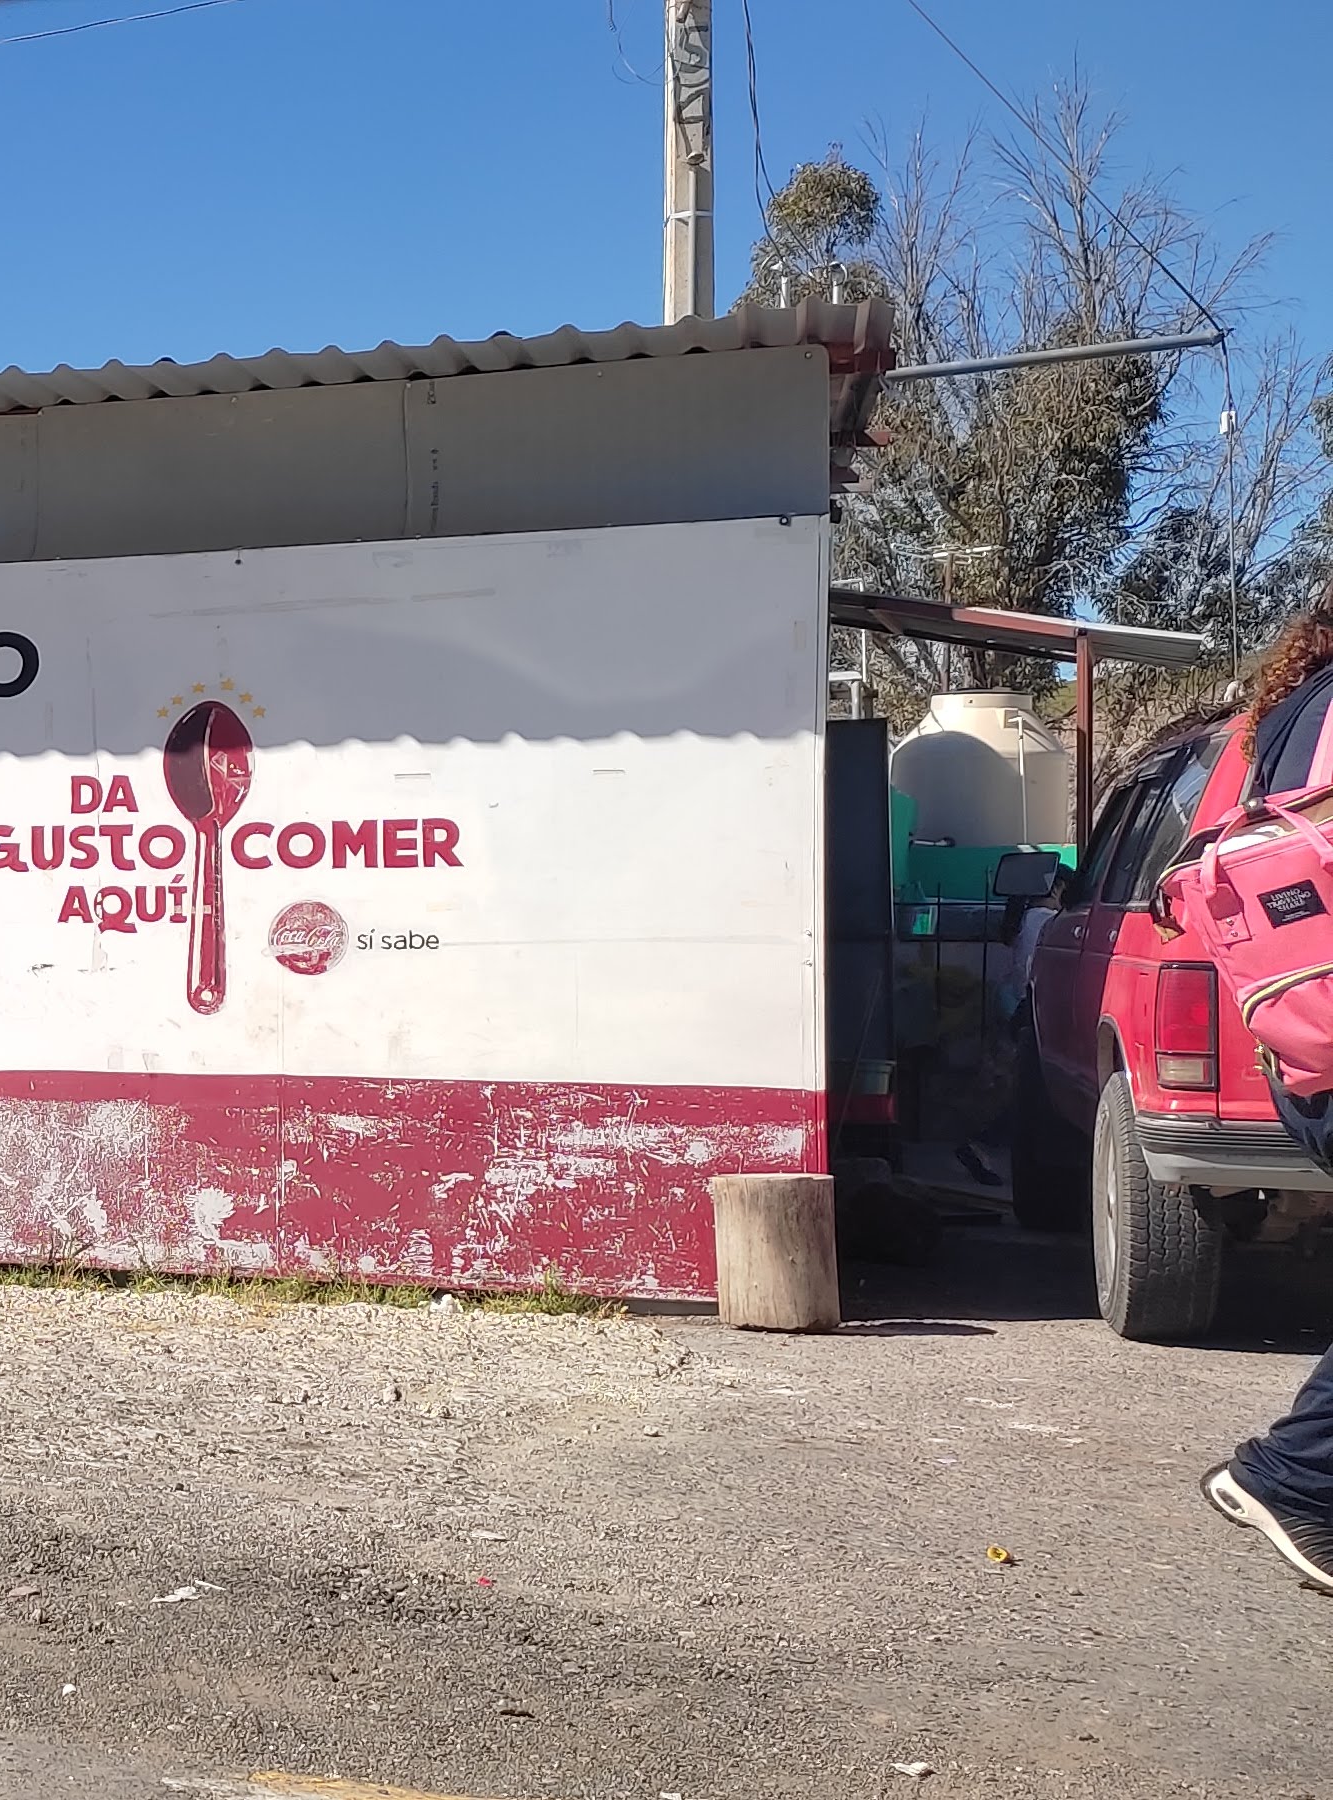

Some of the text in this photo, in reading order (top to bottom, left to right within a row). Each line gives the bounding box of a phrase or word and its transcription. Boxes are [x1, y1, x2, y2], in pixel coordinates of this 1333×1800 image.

[70, 775, 139, 814] DA
[230, 818, 465, 869] COMER
[57, 874, 189, 934] AQUÍ
[356, 928, 375, 950] sí
[381, 930, 440, 950] sabe
